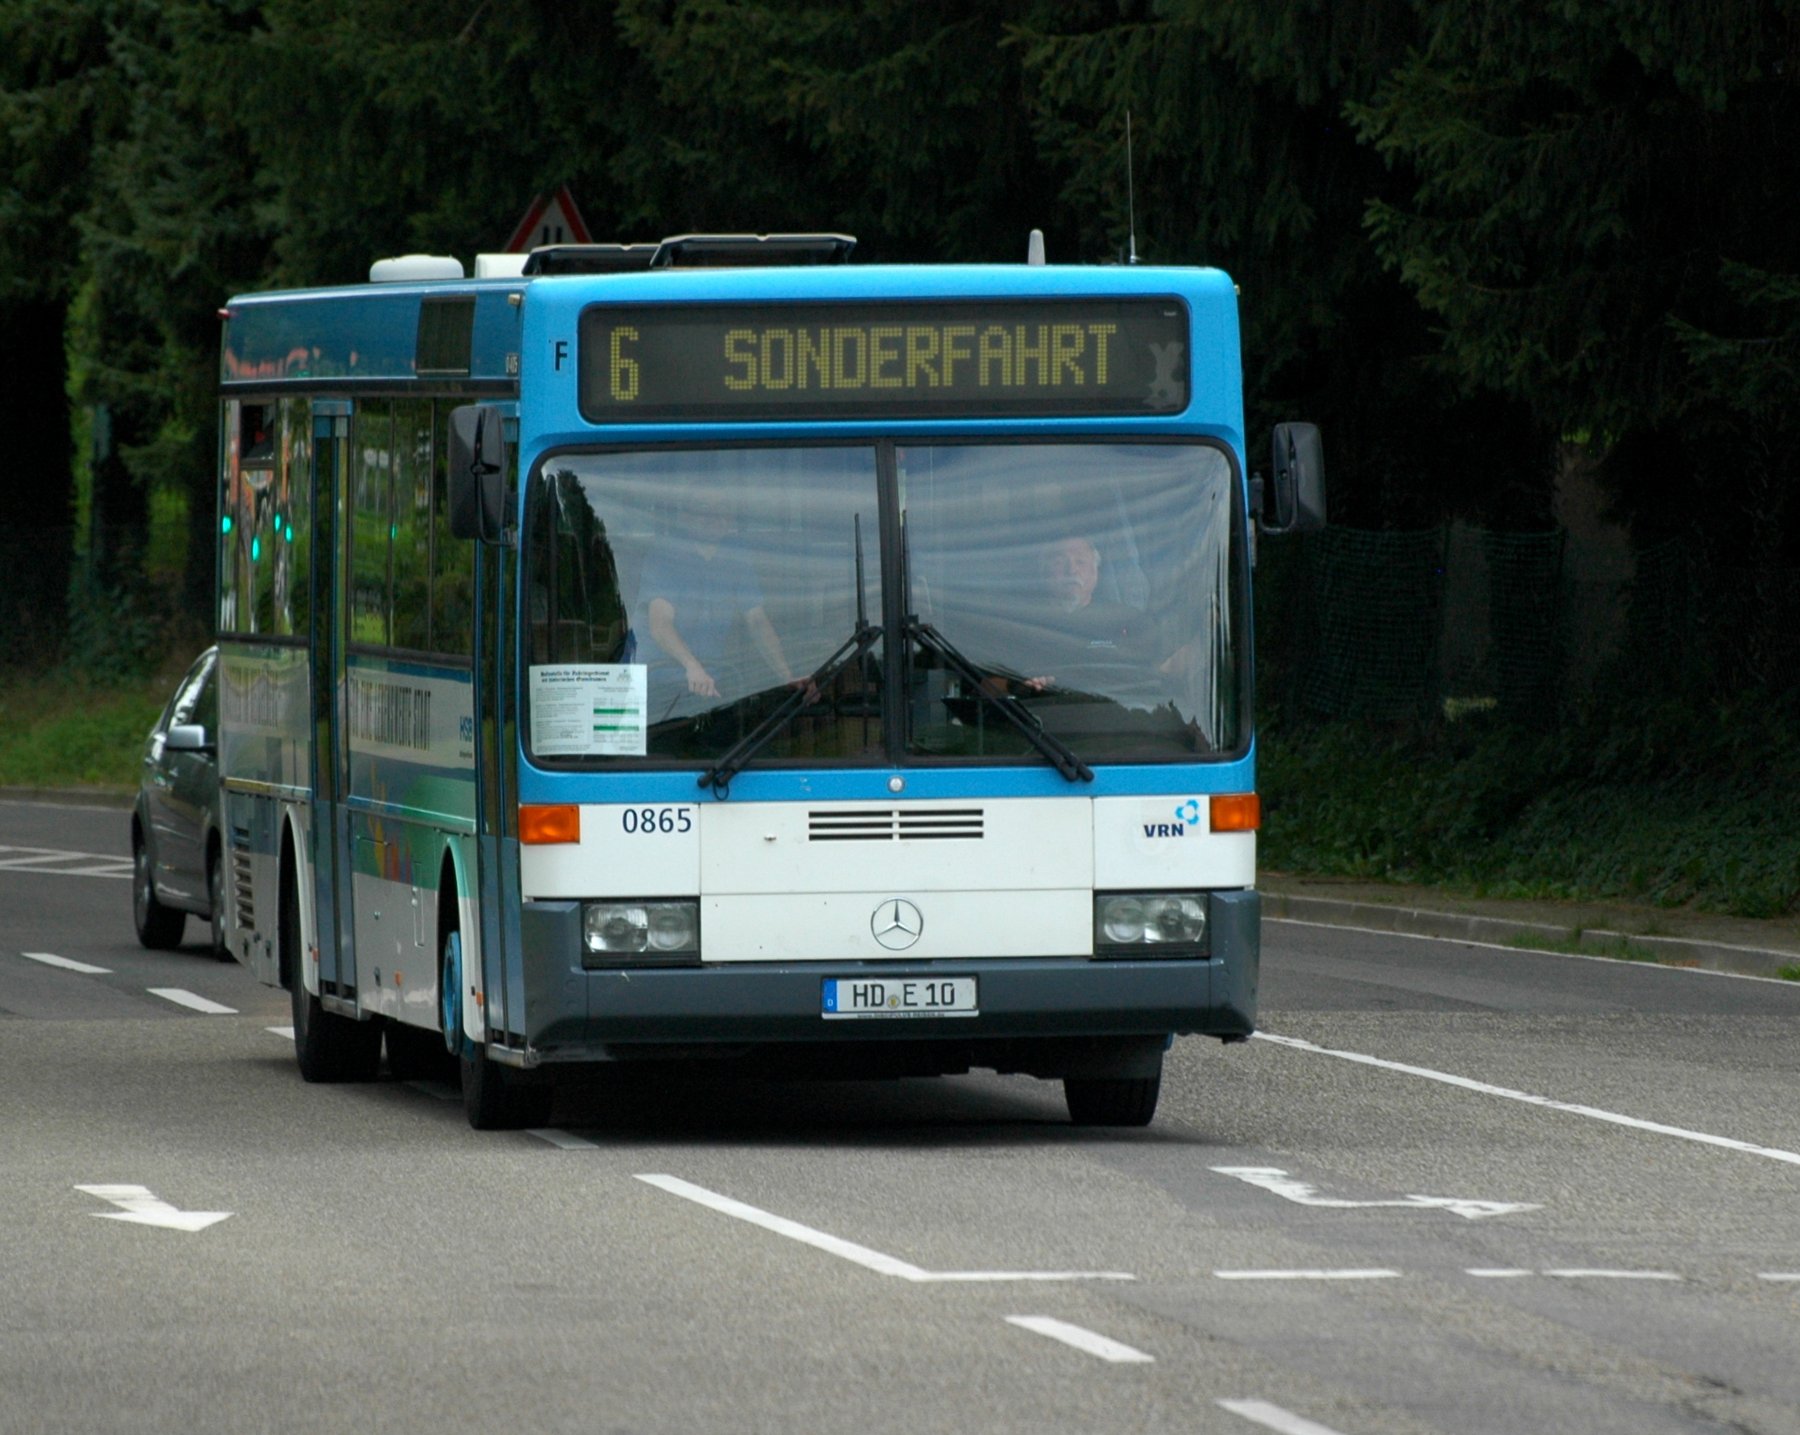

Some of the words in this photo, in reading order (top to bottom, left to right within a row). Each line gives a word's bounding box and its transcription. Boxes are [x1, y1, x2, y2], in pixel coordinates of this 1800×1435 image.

[555, 341, 568, 371] F
[610, 326, 639, 400] 6
[724, 323, 1117, 390] SONDERFAHRT
[622, 808, 692, 833] 0865
[1143, 823, 1184, 838] VRN
[853, 984, 885, 1007] HD
[903, 983, 918, 1006] E
[925, 982, 956, 1006] 10
